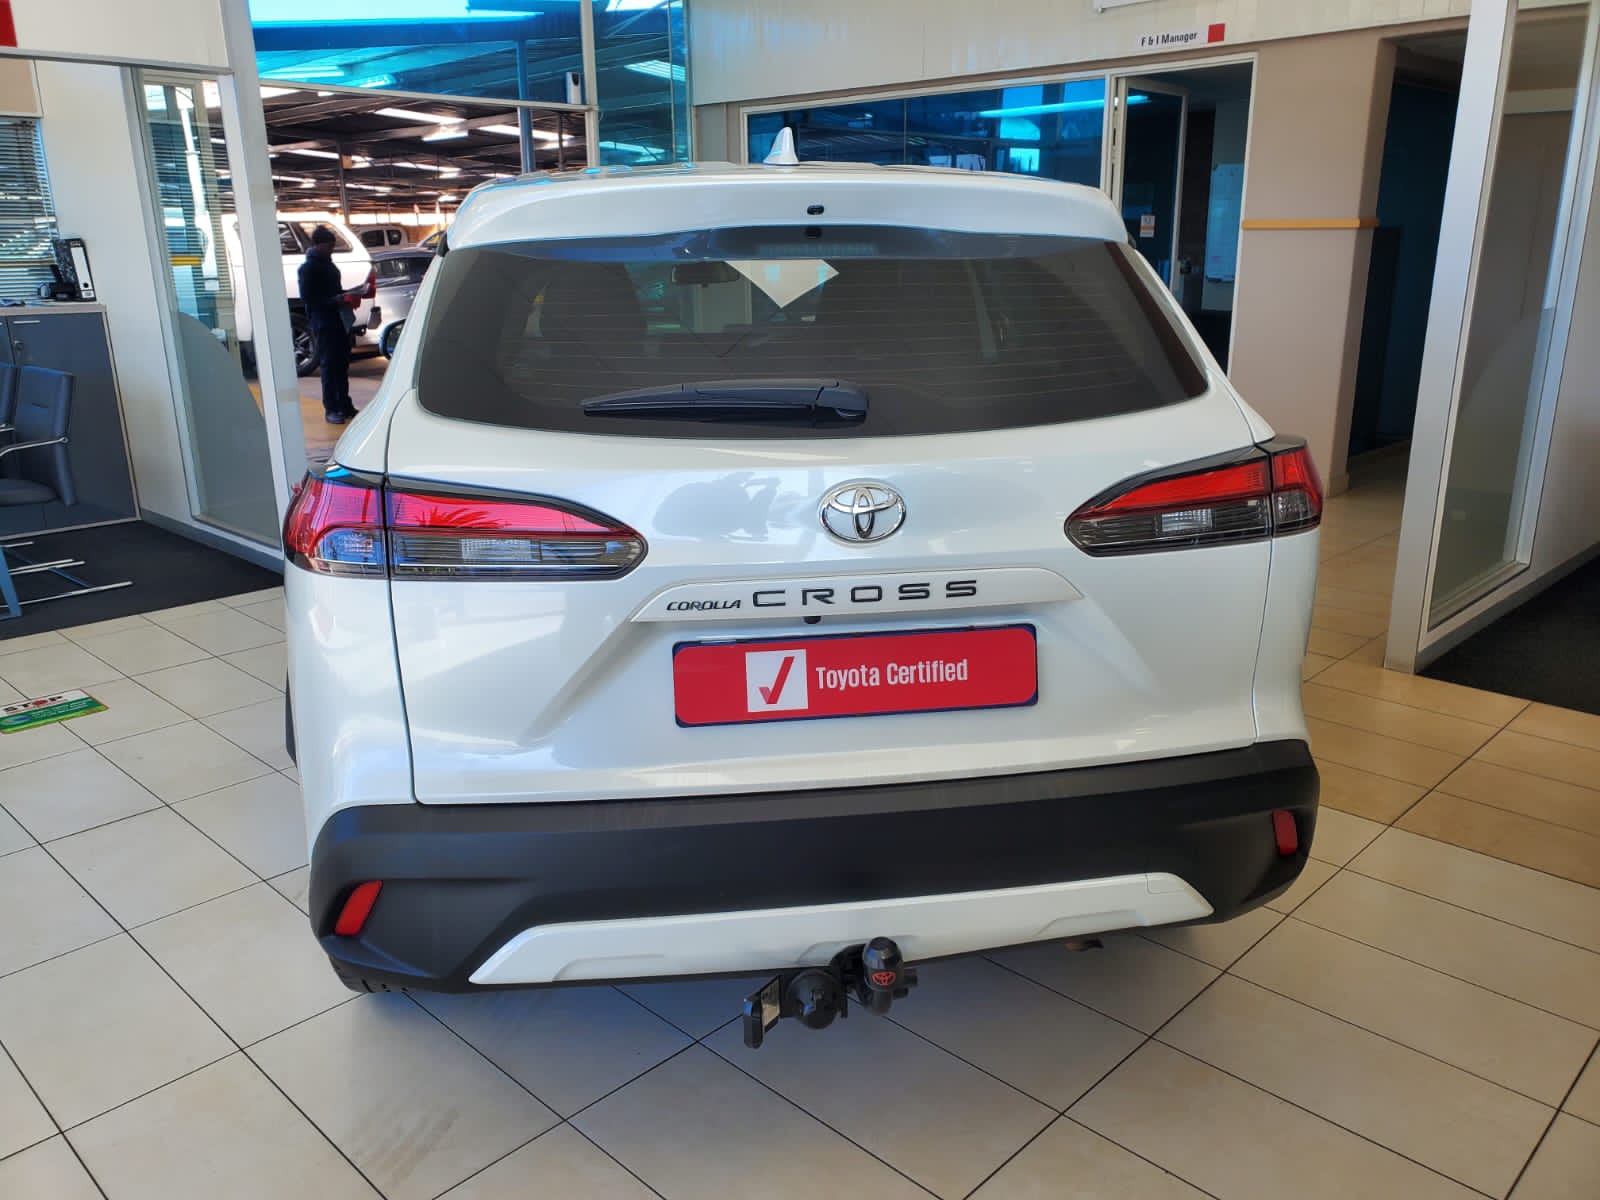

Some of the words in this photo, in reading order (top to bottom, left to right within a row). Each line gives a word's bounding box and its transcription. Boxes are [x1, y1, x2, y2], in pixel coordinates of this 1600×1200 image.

[1148, 36, 1154, 45] &
[1161, 32, 1198, 45] Manager
[666, 599, 742, 612] COROLLA
[752, 579, 977, 608] CROSS
[816, 664, 880, 690] Toyota
[886, 659, 969, 686] Certified
[3, 695, 63, 712] STOP
